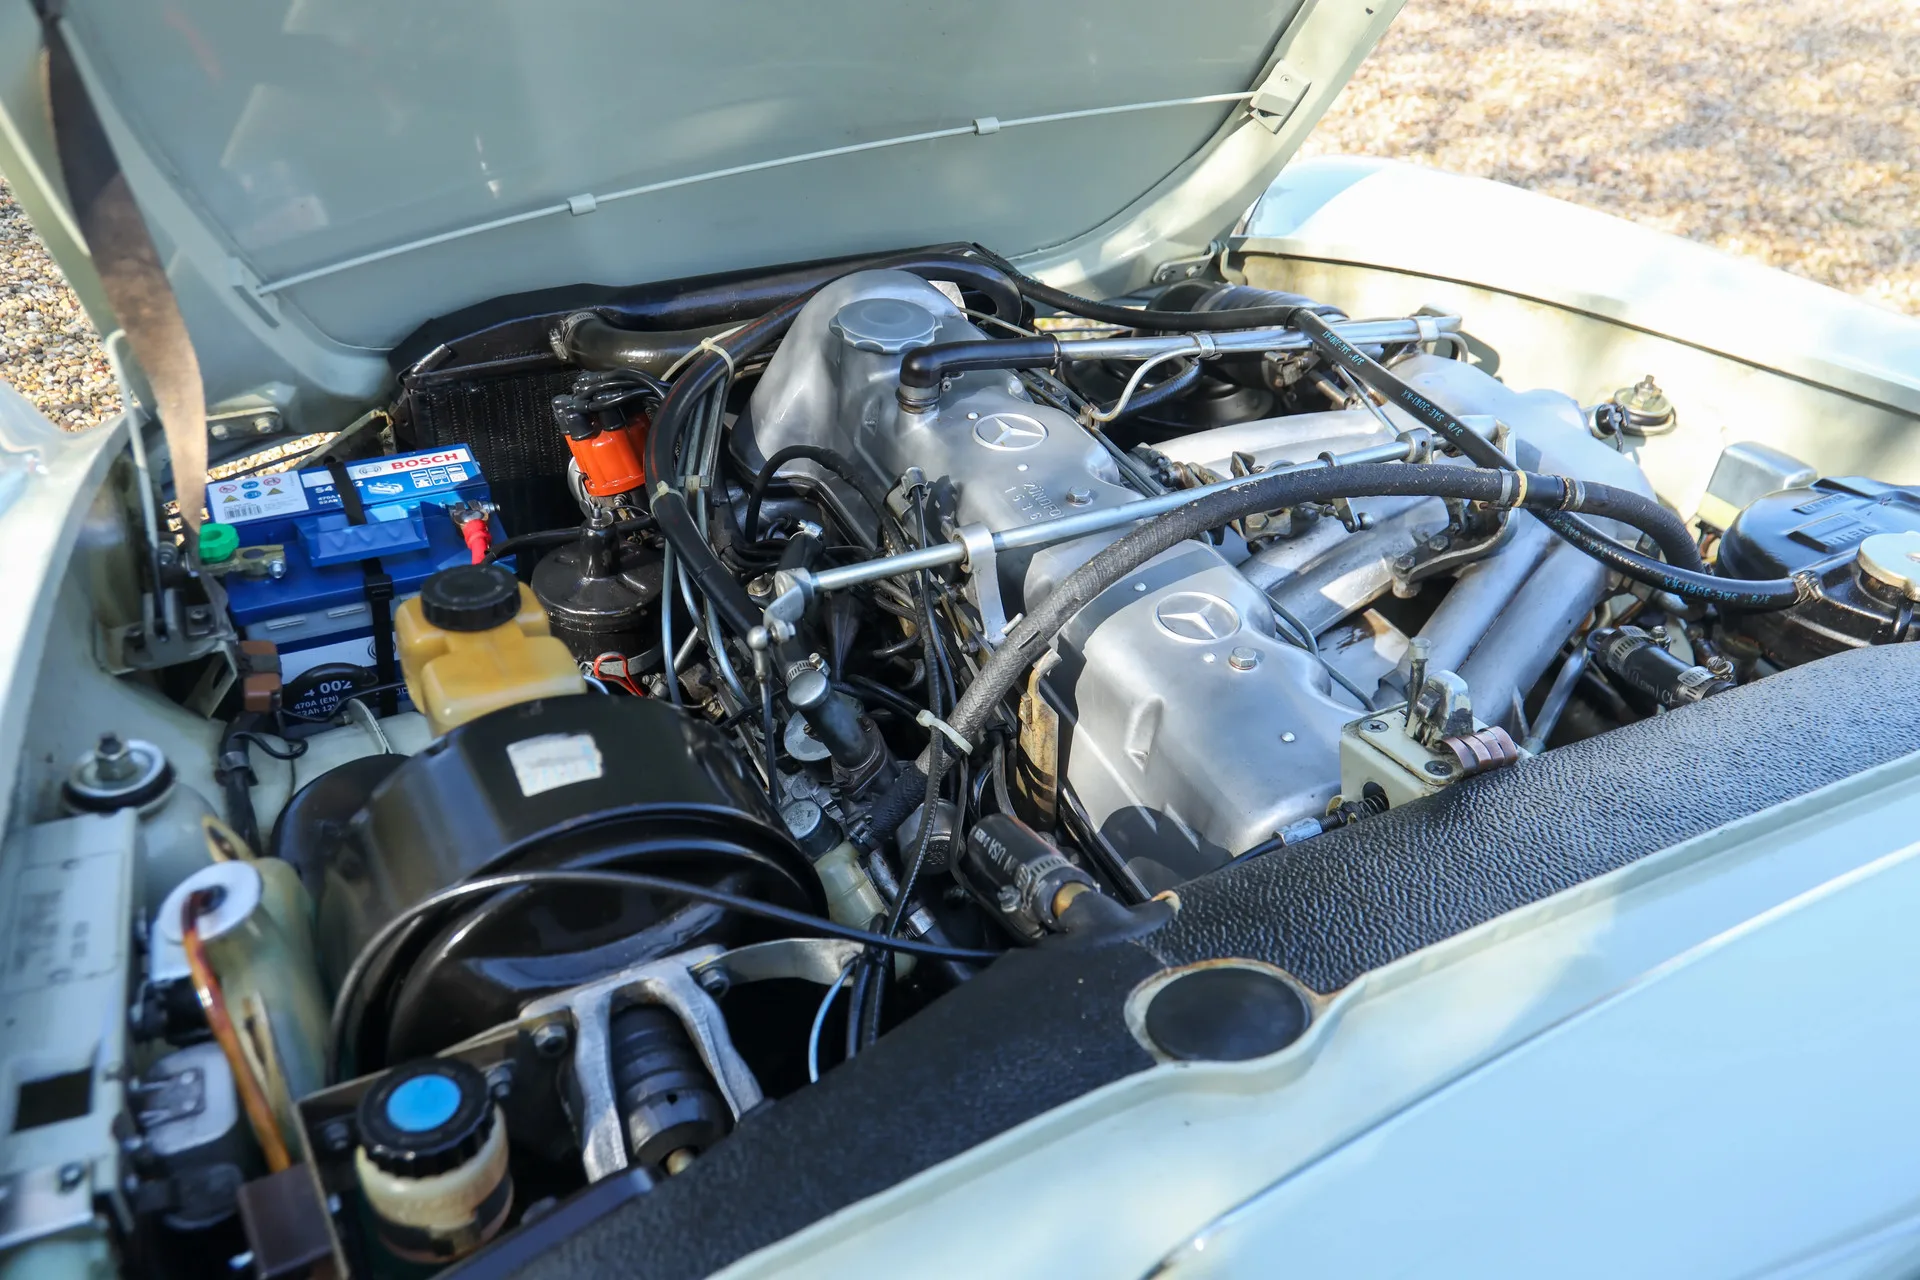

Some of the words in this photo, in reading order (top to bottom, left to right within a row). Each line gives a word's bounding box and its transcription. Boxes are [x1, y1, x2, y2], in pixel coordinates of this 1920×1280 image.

[391, 453, 459, 470] BOSCH
[315, 485, 334, 494] S4
[320, 680, 352, 694] 002
[294, 701, 317, 710] 470A
[320, 695, 339, 705] (EN)
